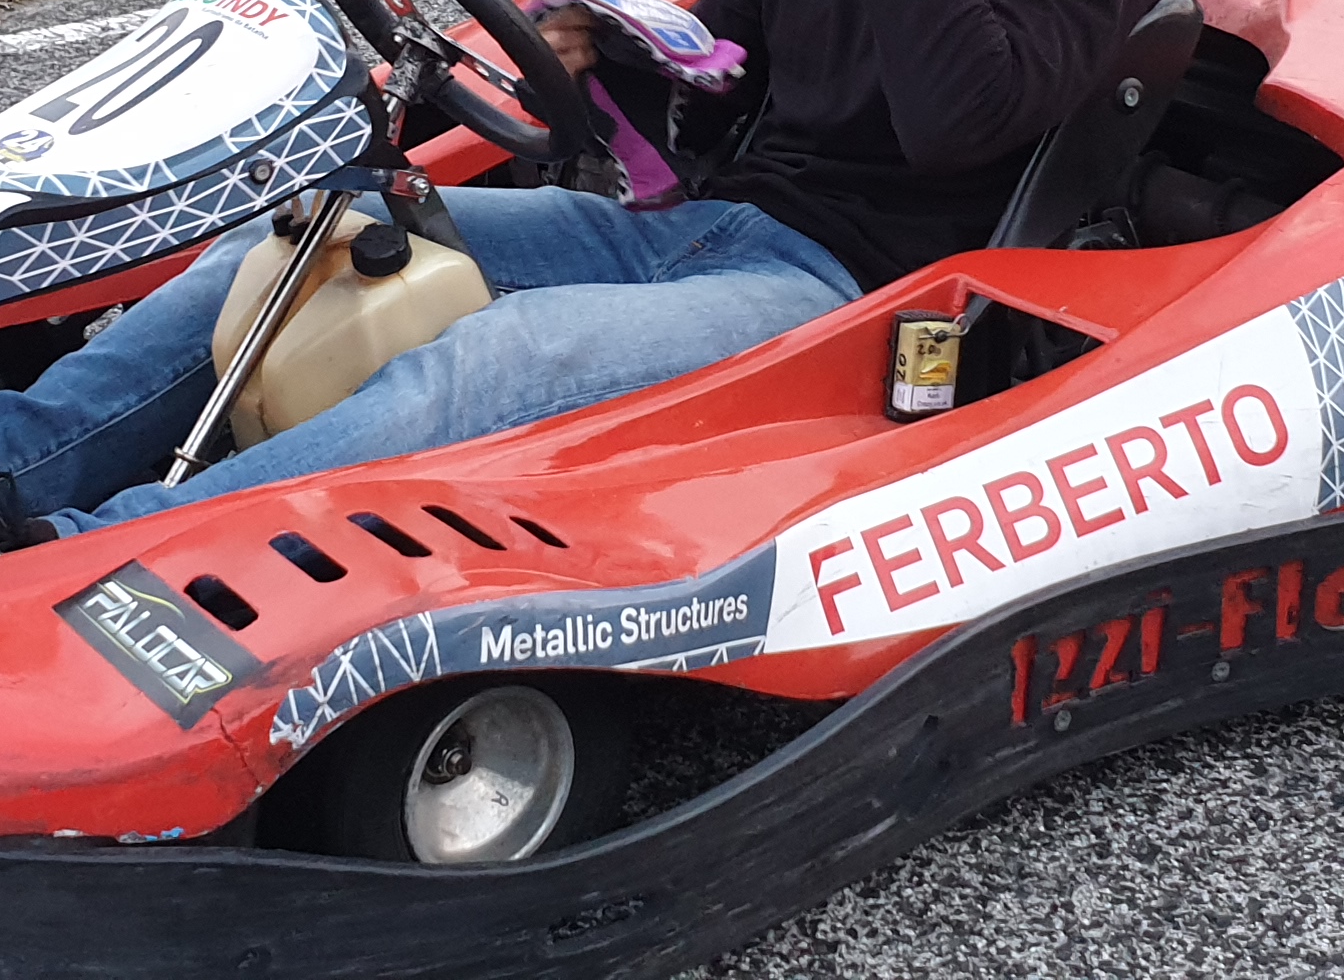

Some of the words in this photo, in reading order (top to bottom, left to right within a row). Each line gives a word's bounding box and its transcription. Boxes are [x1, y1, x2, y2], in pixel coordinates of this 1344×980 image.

[28, 7, 224, 135] 20
[809, 384, 1290, 637] FERBERTO
[84, 577, 231, 702] PALOCAR
[480, 617, 613, 665] Metallic
[619, 593, 749, 646] Structures
